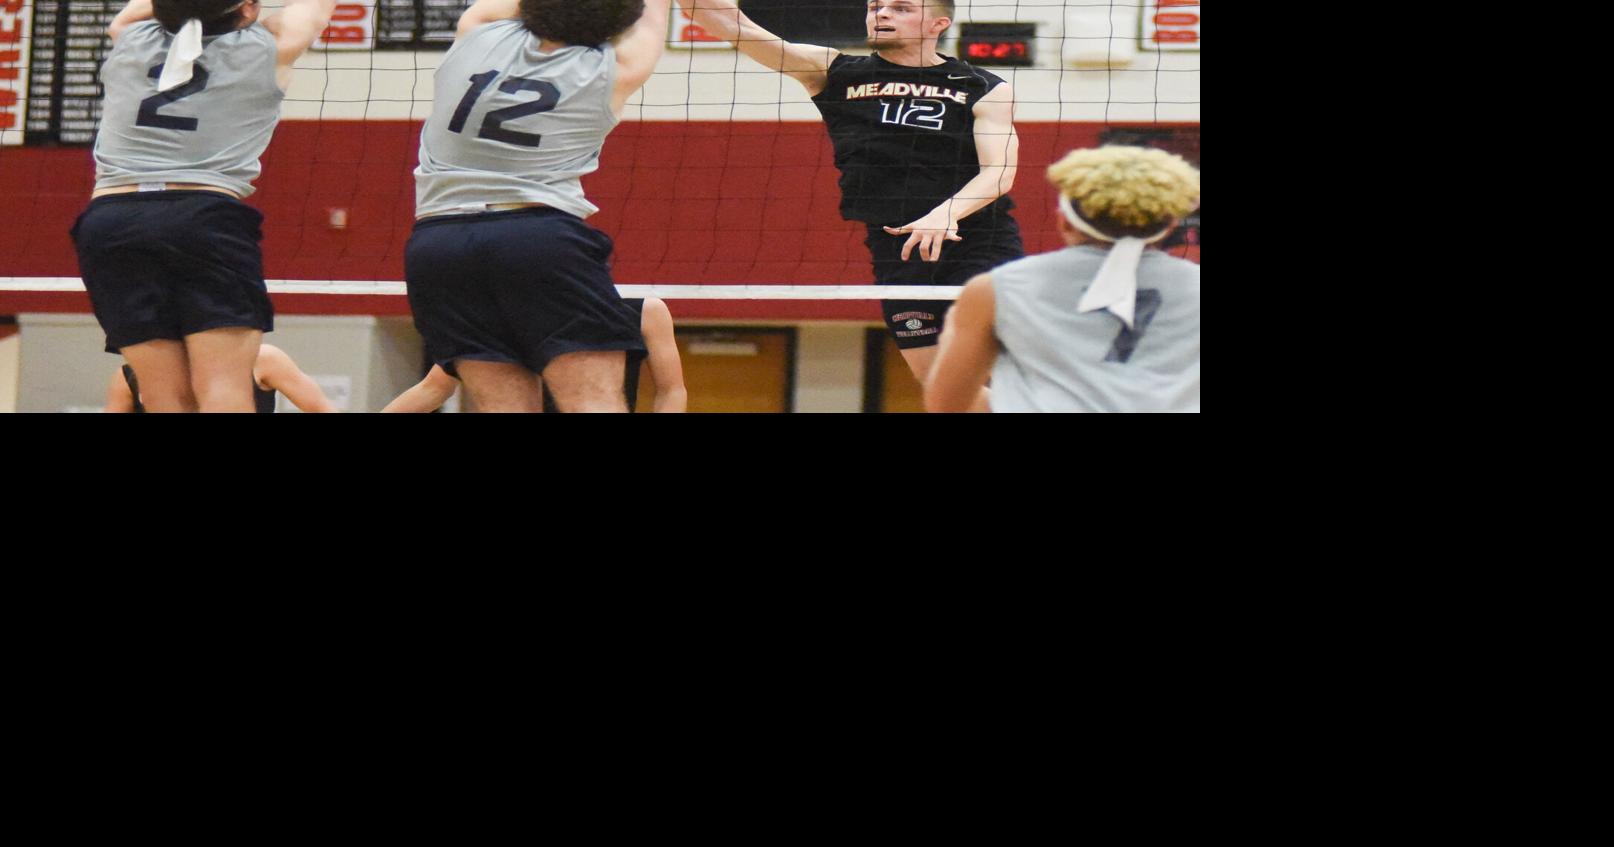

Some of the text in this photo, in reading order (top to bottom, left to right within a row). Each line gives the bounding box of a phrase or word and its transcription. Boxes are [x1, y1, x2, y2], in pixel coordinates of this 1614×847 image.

[136, 56, 210, 131] 2
[447, 69, 561, 148] 12
[846, 82, 969, 105] MEADVILLE
[879, 98, 946, 131] 12
[1083, 286, 1163, 364] 7
